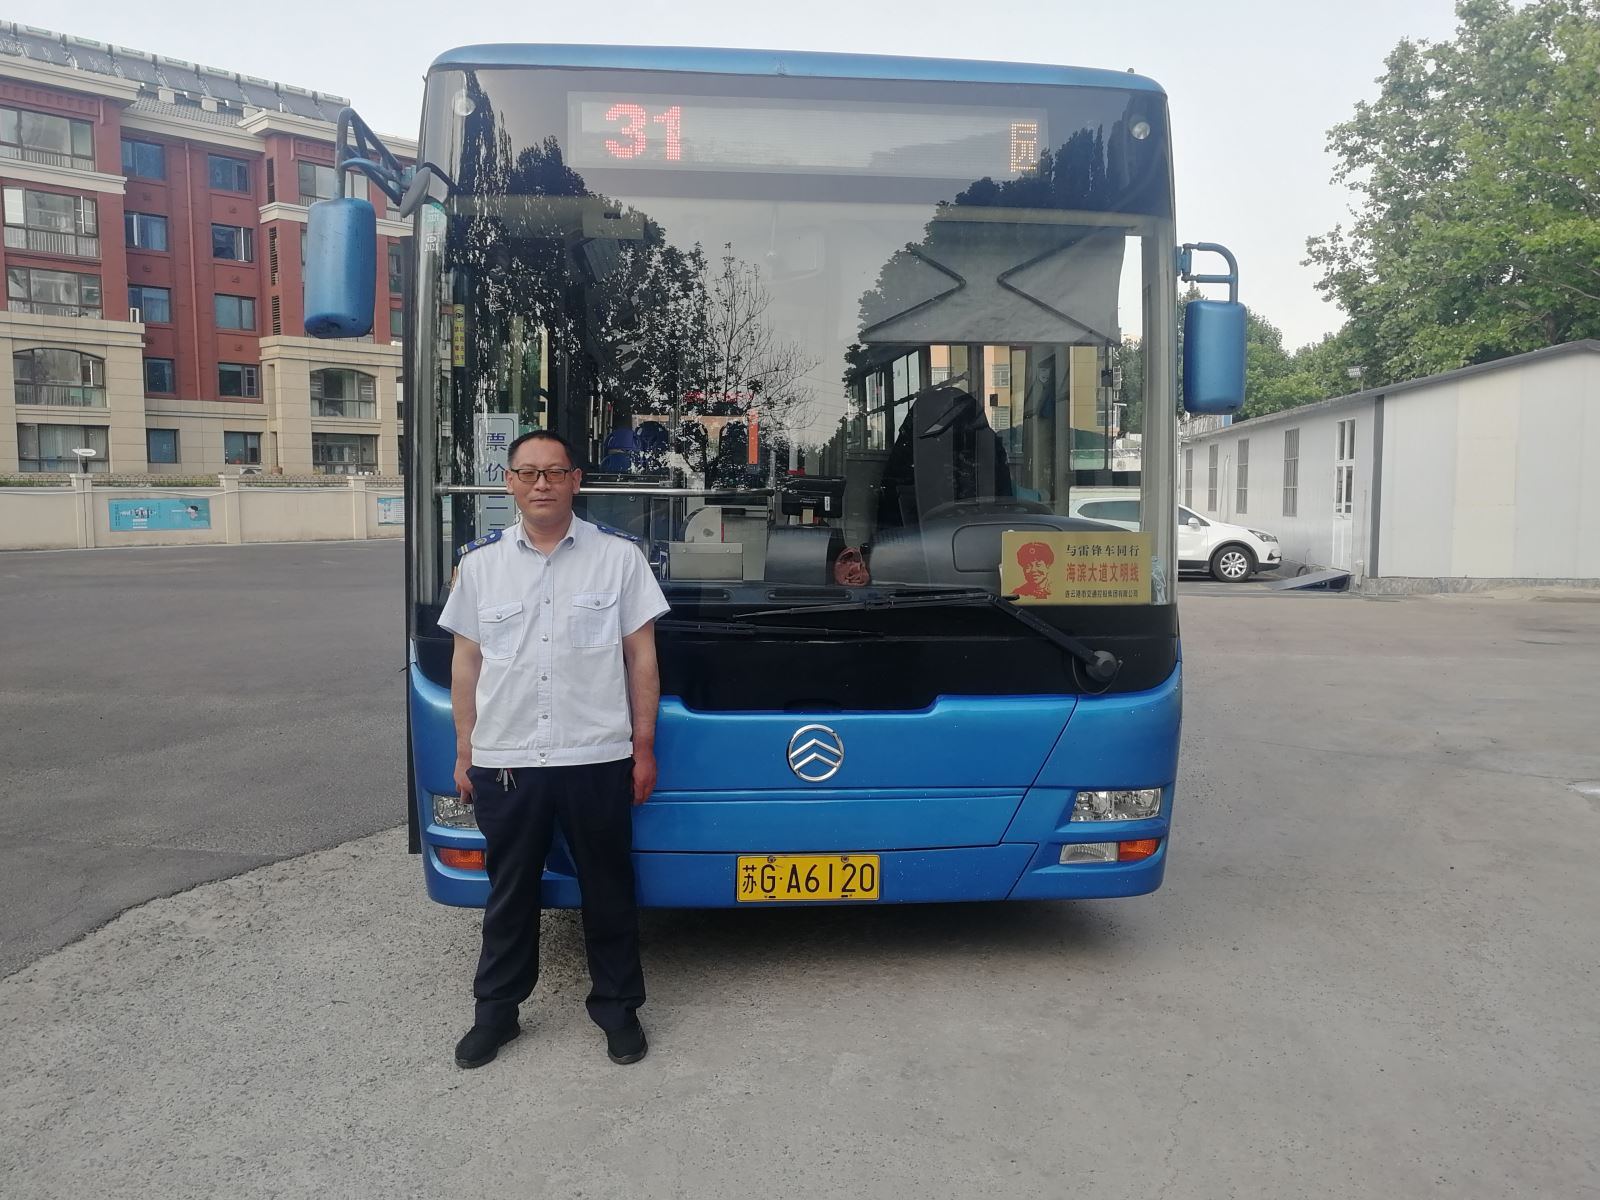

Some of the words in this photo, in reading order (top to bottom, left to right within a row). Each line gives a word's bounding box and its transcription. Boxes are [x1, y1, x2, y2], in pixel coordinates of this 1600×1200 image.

[603, 102, 682, 161] 31
[1066, 544, 1140, 557] 与雷锋车同行
[1066, 562, 1140, 583] 海滨大道文明线
